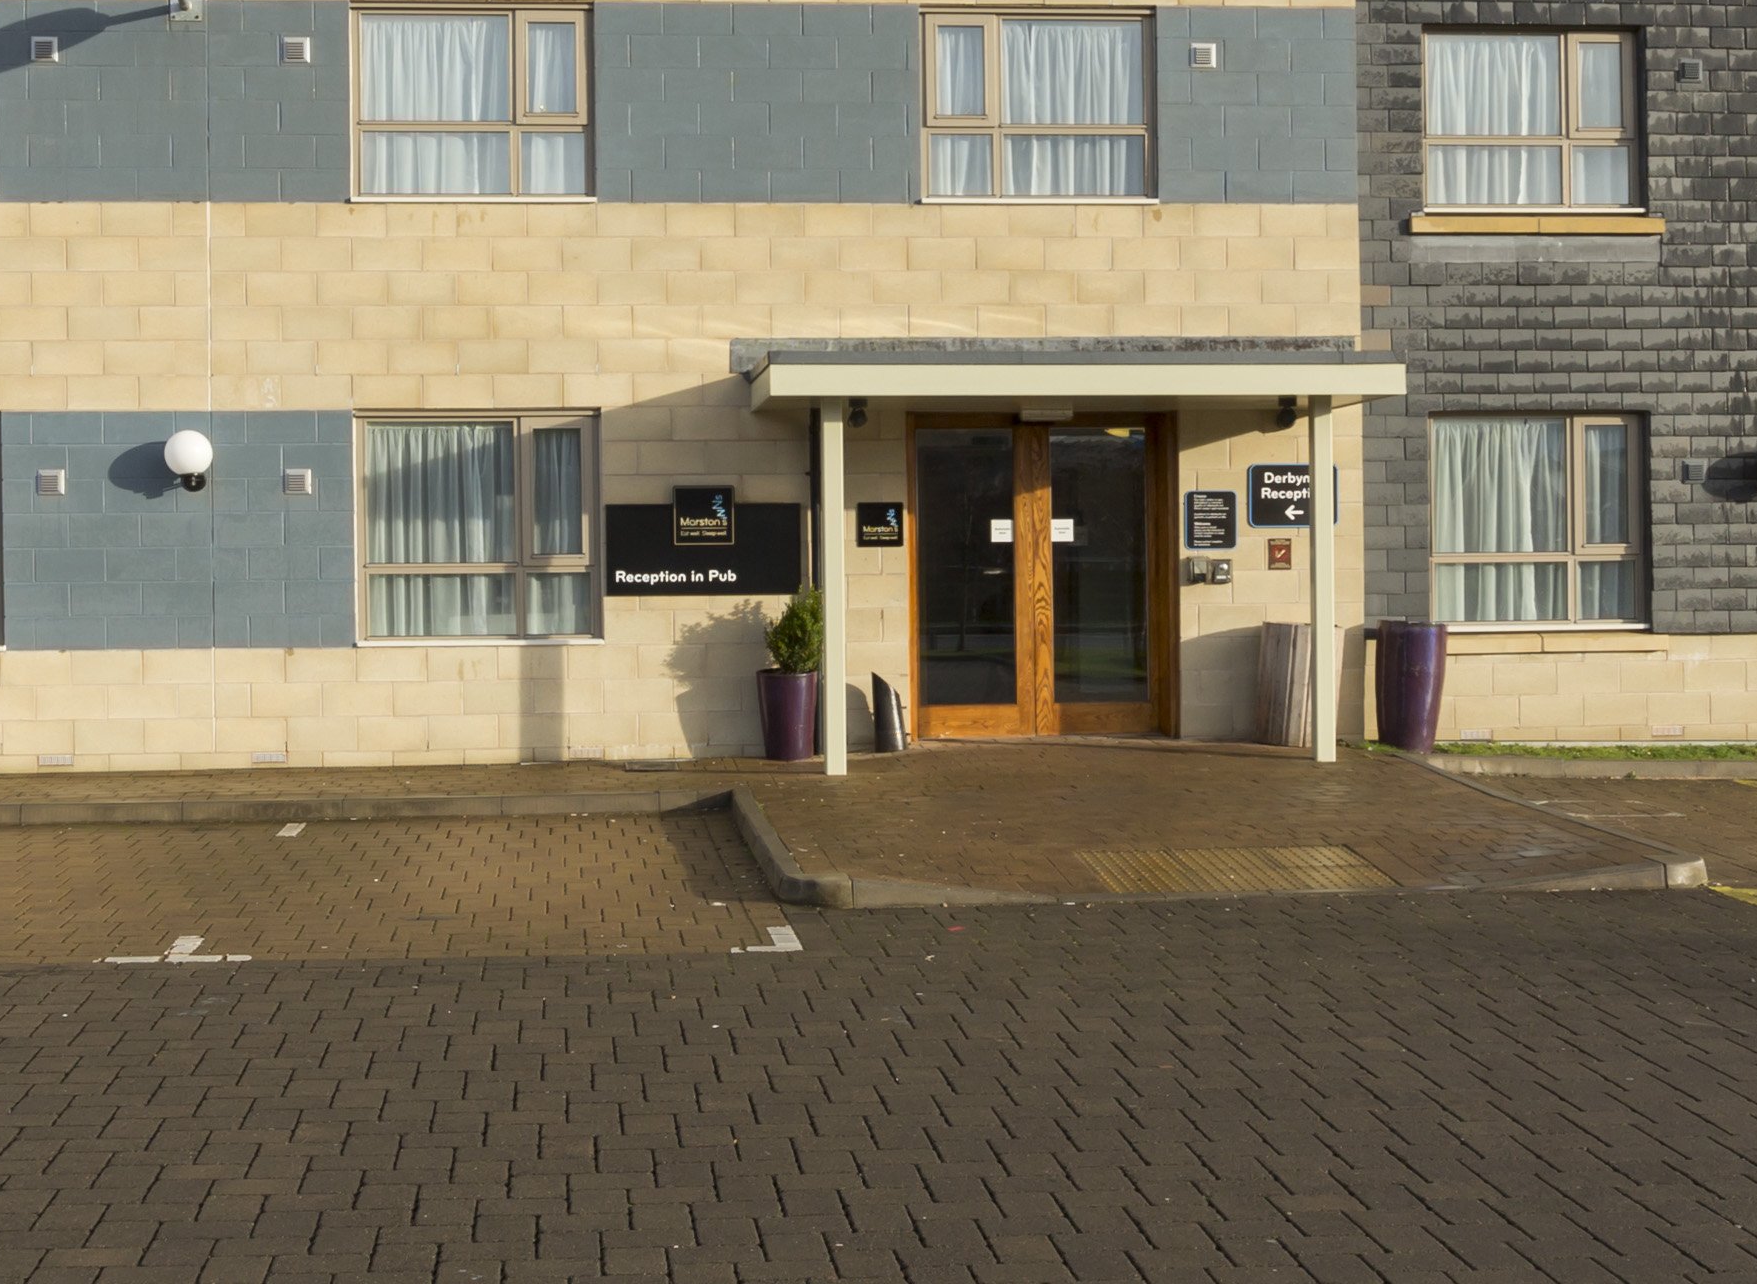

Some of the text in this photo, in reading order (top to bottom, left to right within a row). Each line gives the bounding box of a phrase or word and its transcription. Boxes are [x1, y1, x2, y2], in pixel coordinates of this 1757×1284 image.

[1264, 471, 1310, 486] Derbyn
[1261, 487, 1310, 501] Recepti
[615, 569, 737, 586] Reception in Pub
